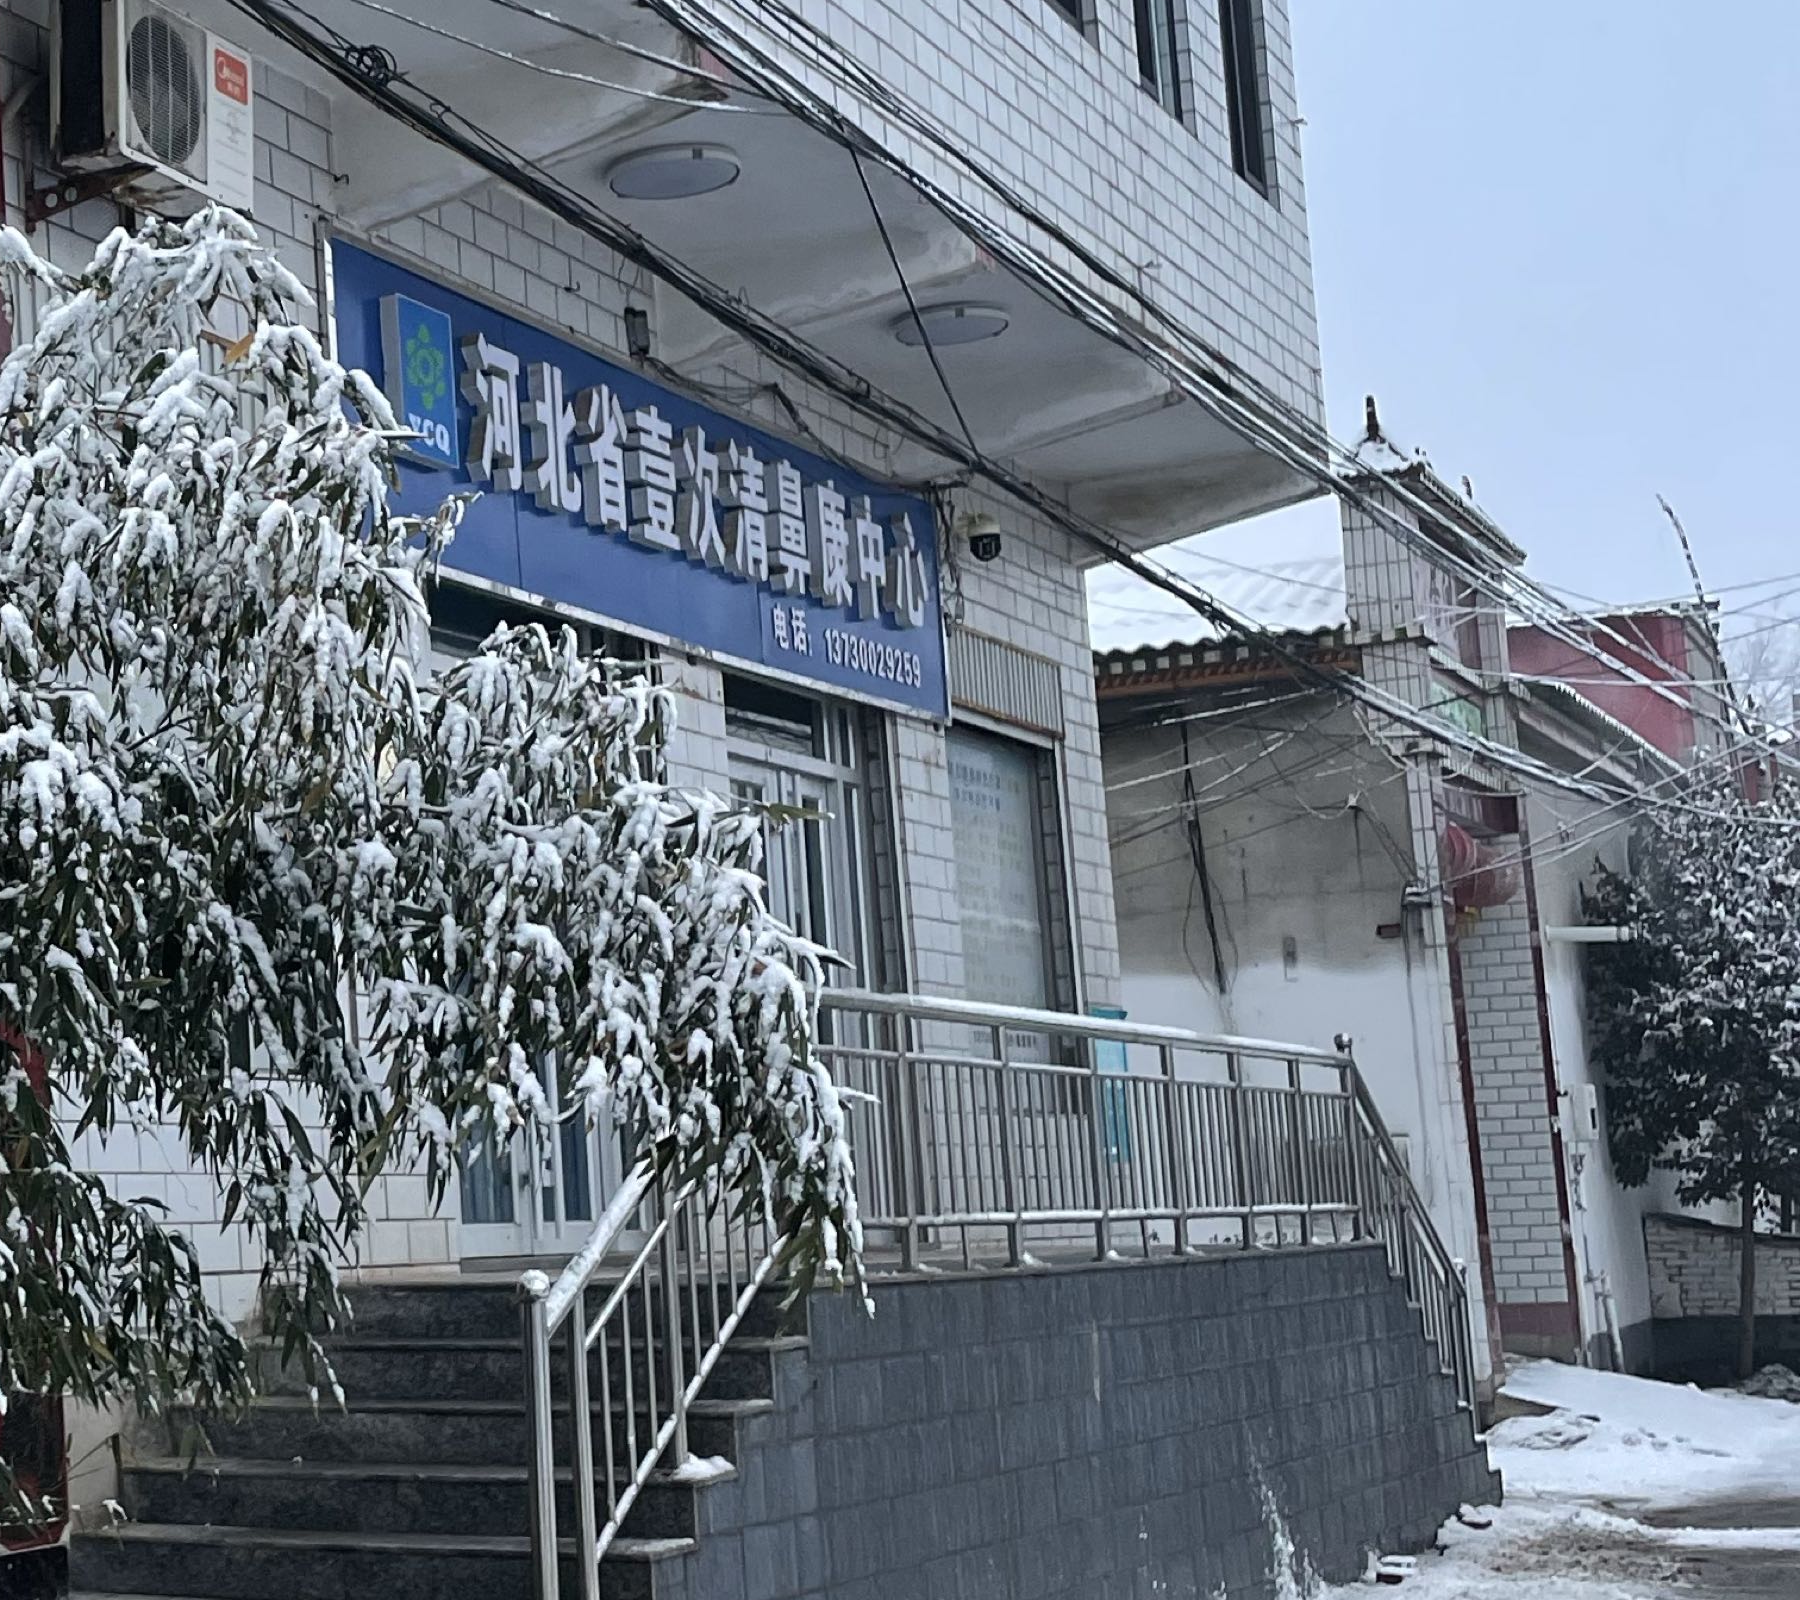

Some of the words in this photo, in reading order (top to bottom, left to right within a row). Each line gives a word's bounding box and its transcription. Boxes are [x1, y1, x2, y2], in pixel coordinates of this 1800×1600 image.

[470, 331, 930, 628] 河北省壹次清鼻康中心
[823, 627, 922, 689] 13730029259
